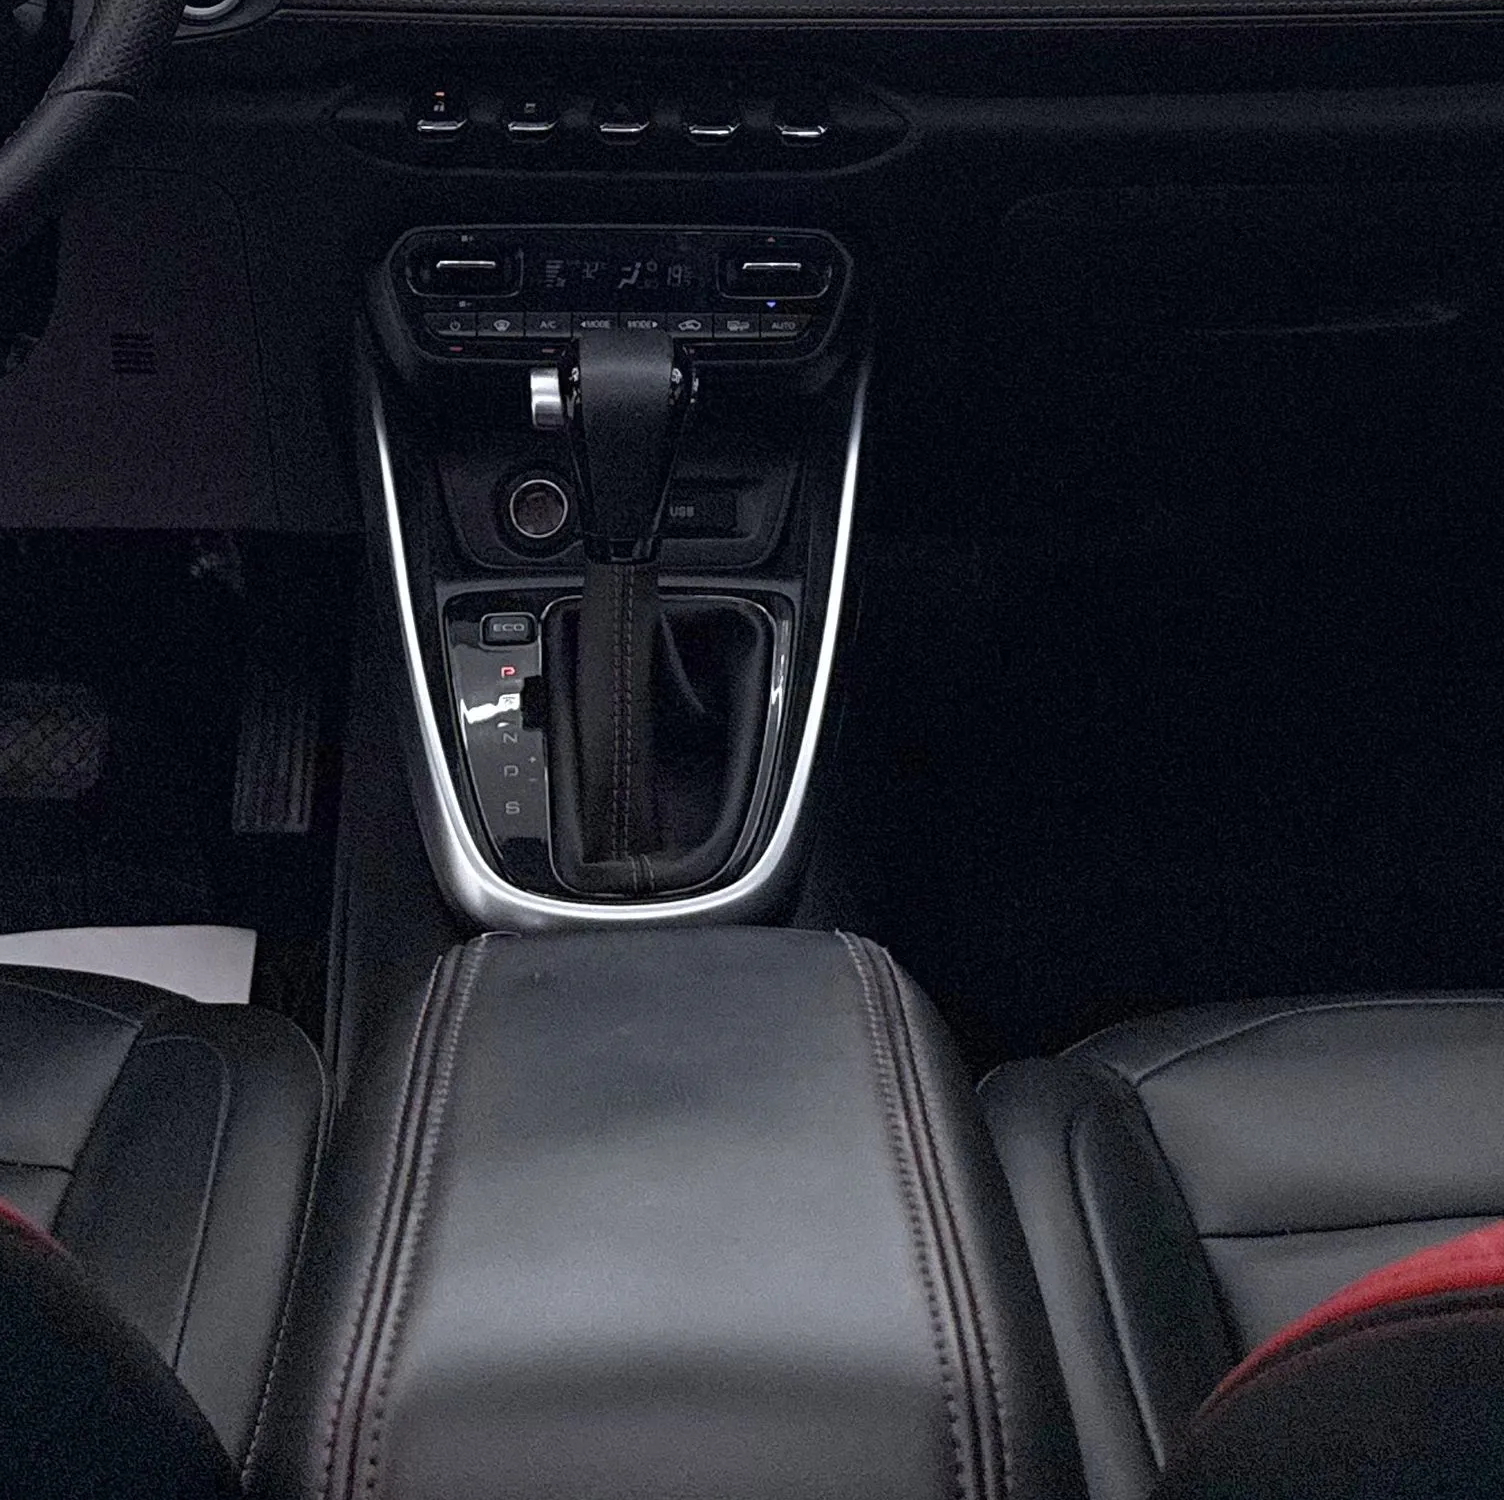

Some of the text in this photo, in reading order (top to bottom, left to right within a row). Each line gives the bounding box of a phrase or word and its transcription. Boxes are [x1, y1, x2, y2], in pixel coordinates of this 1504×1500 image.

[539, 320, 557, 329] A/C
[771, 321, 796, 330] AUTO
[493, 623, 525, 632] ECO
[501, 666, 516, 678] P
[503, 732, 518, 743] N
[505, 801, 520, 814] S
